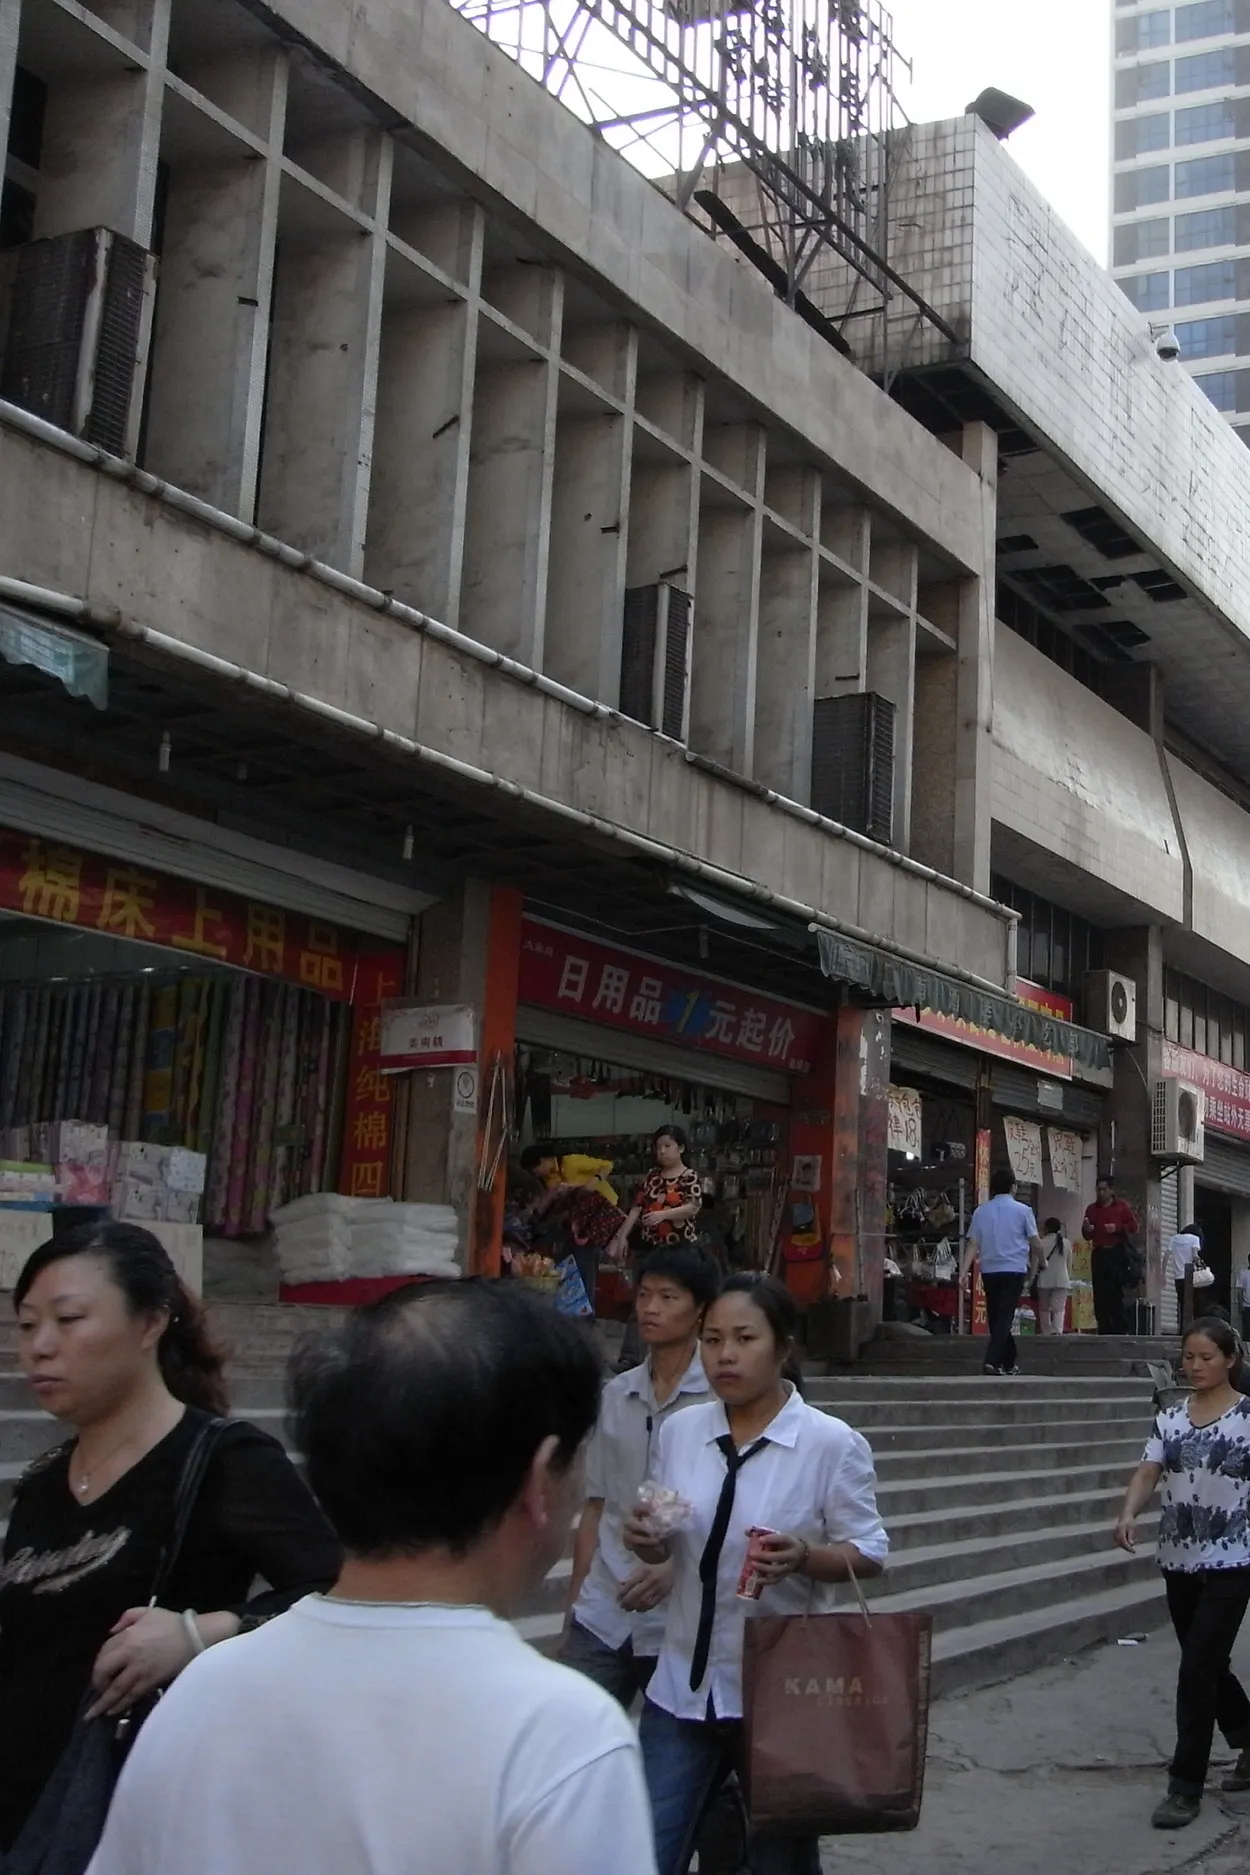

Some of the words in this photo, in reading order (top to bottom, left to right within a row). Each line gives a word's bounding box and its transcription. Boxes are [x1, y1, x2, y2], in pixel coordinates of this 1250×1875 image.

[18, 842, 344, 992] 棉床上用品
[785, 1676, 863, 1695] KAMA
